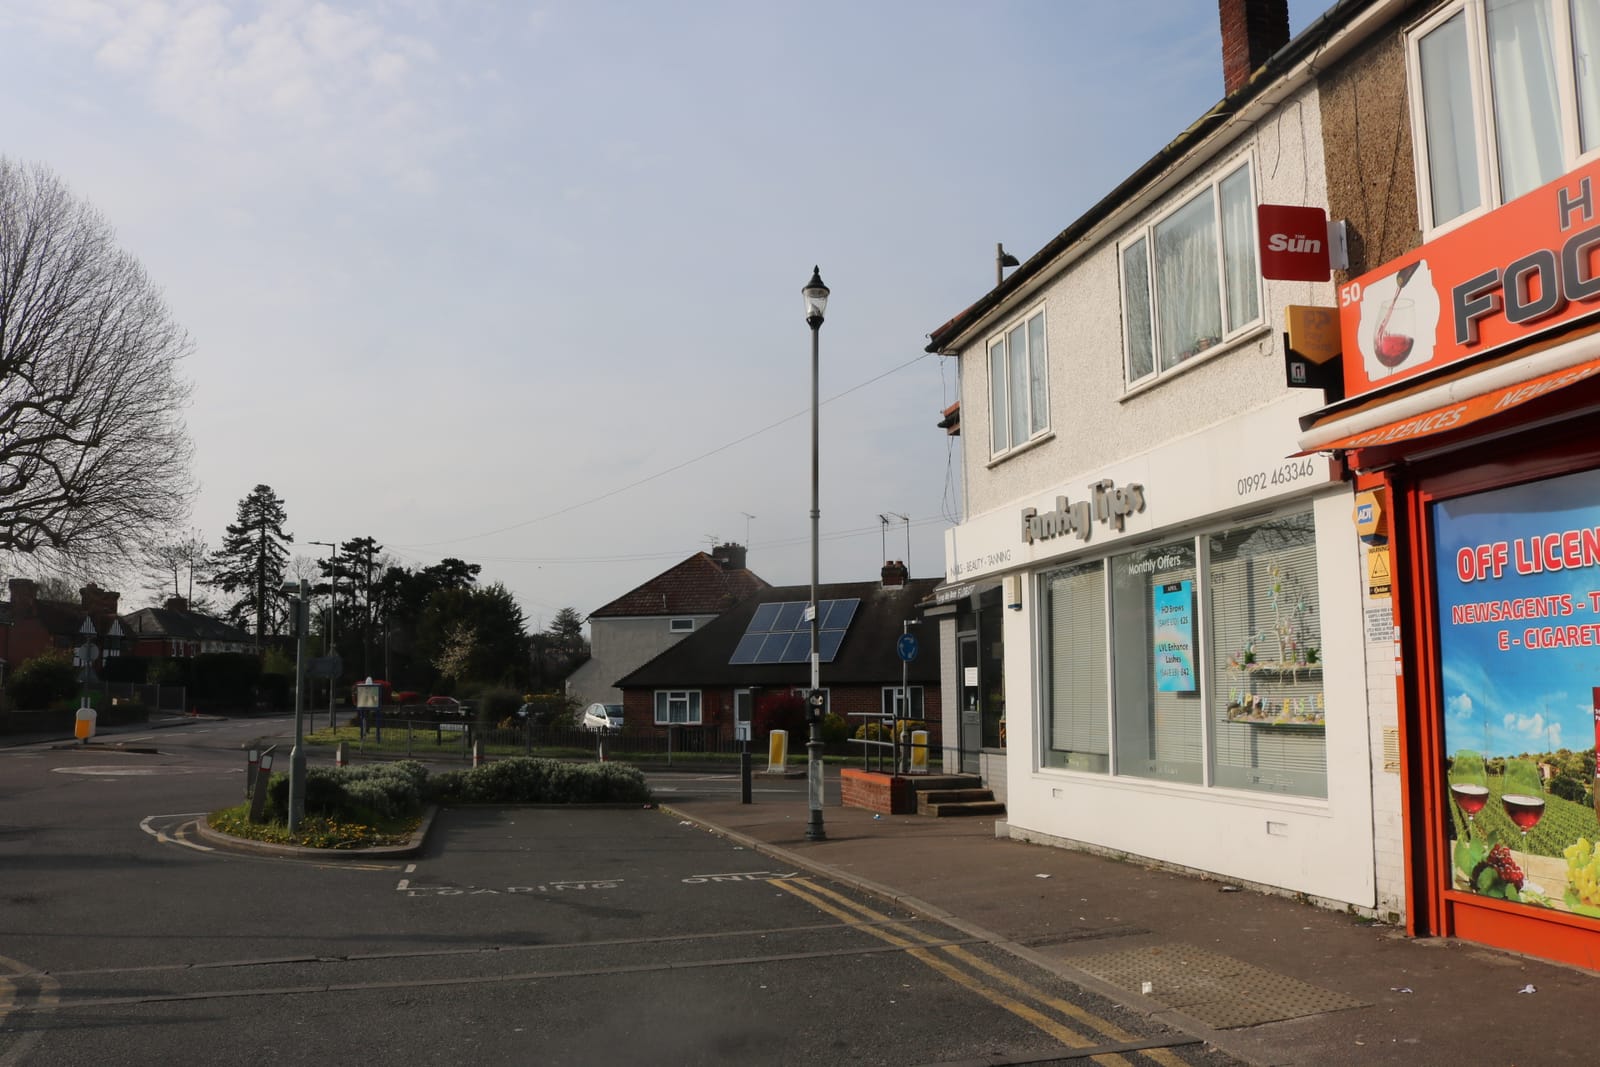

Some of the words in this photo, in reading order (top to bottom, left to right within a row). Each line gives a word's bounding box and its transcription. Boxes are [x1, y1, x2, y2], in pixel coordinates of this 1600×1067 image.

[1268, 233, 1321, 254] Sun
[1342, 282, 1361, 307] 50
[1237, 472, 1267, 496] 01992
[1271, 458, 1314, 485] 463346
[1020, 495, 1092, 545] Funky
[1088, 478, 1146, 532] Tips
[1358, 508, 1373, 522] ADT
[966, 558, 983, 573] BEAUTY
[987, 549, 1011, 567] TANNING
[1128, 558, 1156, 575] Monthly
[1157, 554, 1181, 570] Offers
[1457, 542, 1508, 583] OFF
[1452, 593, 1572, 625] NEWSAGENTS
[1168, 642, 1189, 652] Enhance
[1166, 655, 1182, 664] Lashes
[407, 881, 620, 897] LOADING
[681, 871, 799, 884] ONLY
